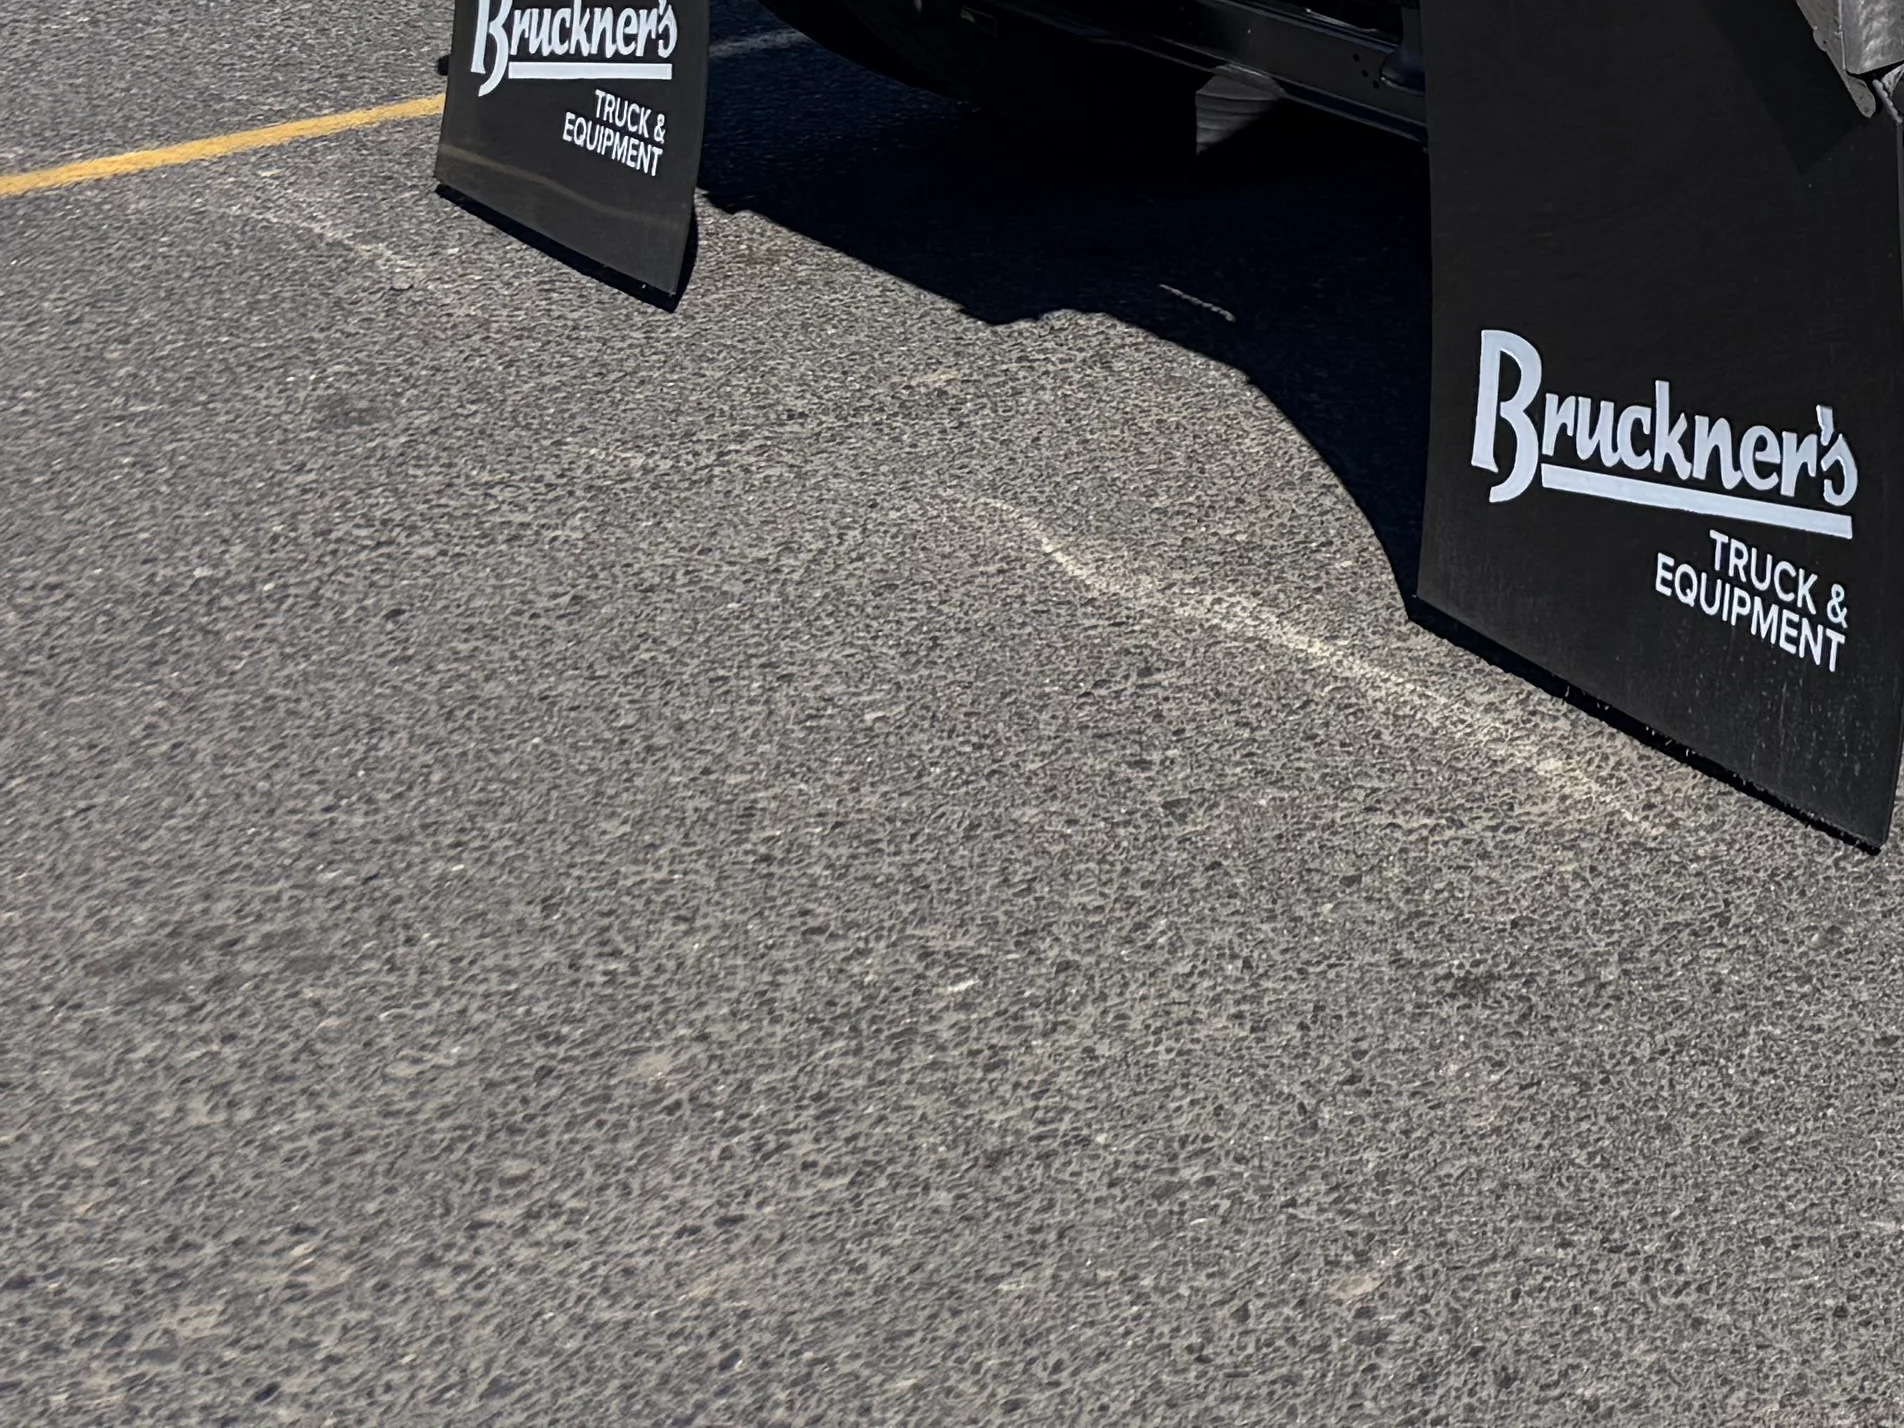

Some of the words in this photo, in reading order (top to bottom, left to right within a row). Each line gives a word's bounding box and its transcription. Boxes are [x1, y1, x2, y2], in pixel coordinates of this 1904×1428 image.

[562, 111, 663, 177] EQUIPMENT
[595, 89, 650, 139] TRUCK
[653, 113, 666, 144] &
[1471, 329, 1859, 507] Bruckner's
[1655, 552, 1846, 673] EQUIPMENT
[1709, 529, 1818, 615] TRUCK
[1826, 584, 1849, 629] &
